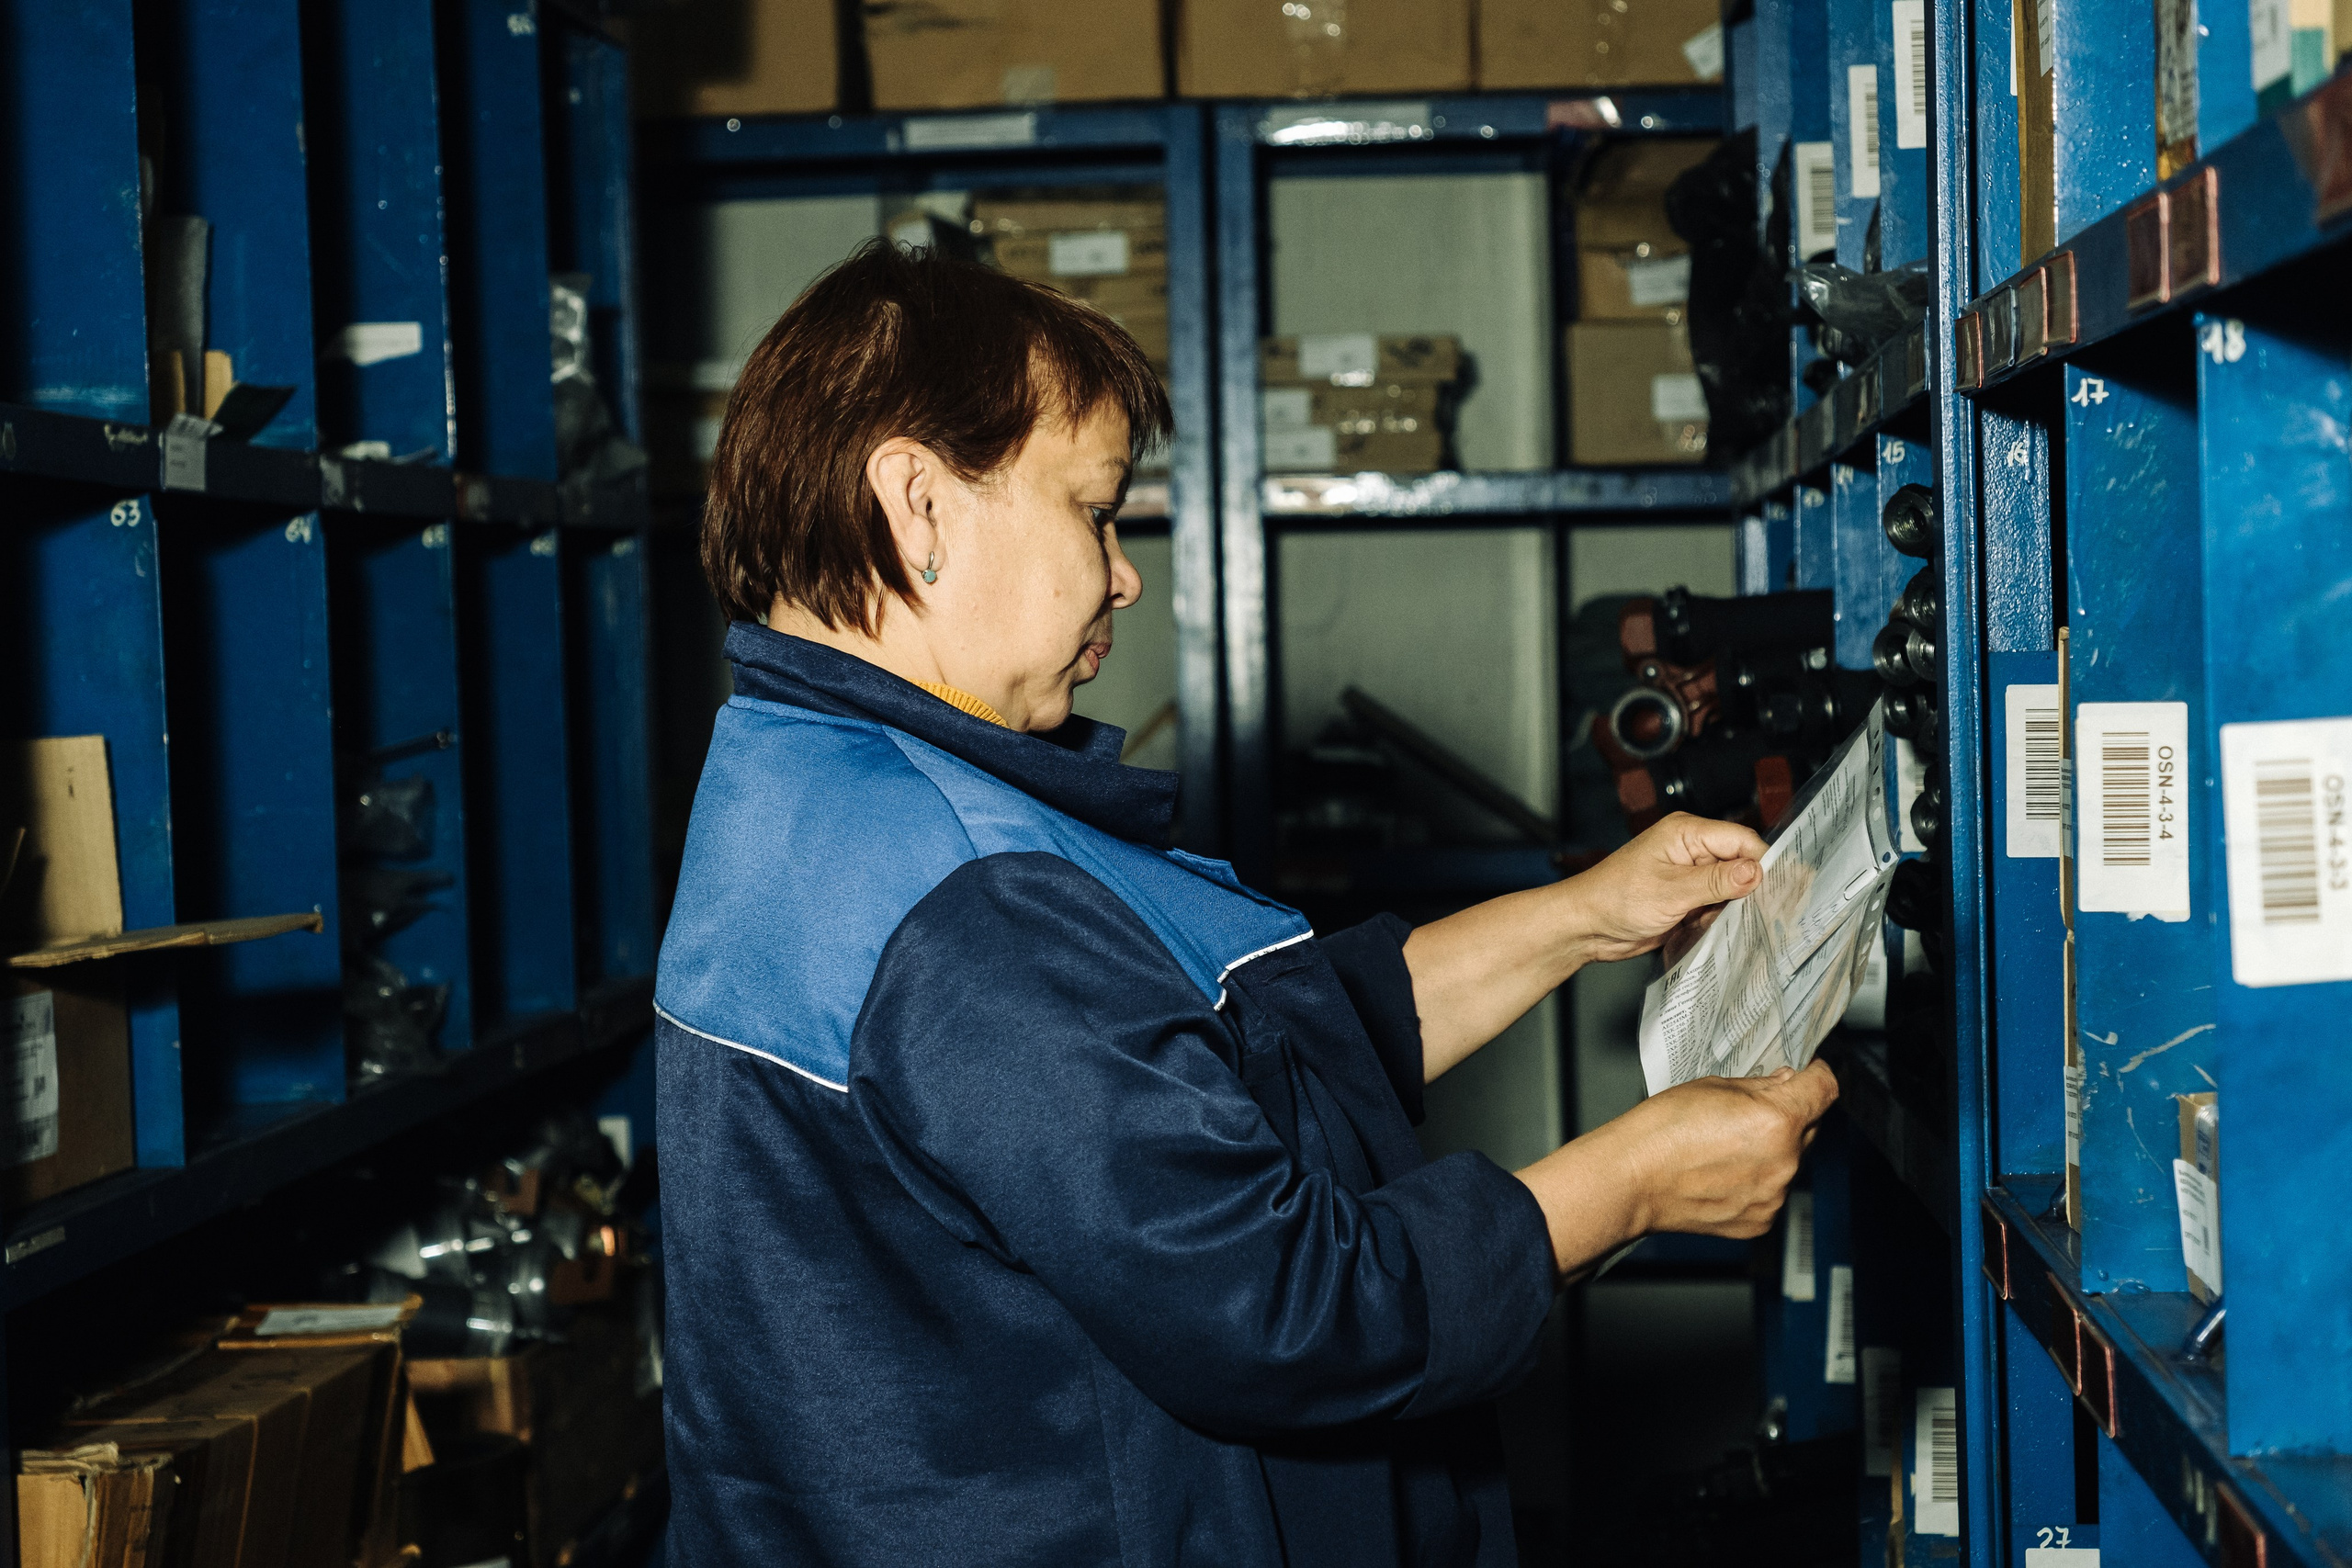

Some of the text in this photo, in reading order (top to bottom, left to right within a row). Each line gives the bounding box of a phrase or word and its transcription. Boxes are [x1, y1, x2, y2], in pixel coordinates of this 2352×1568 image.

[2202, 321, 2246, 365] 18
[2071, 378, 2109, 407] 17
[1882, 440, 1905, 464] 15
[110, 499, 141, 527] 63
[2157, 745, 2175, 840] OSN-4-3-4
[2324, 774, 2349, 890] OSN-4-3-3
[2037, 1526, 2072, 1550] 27
